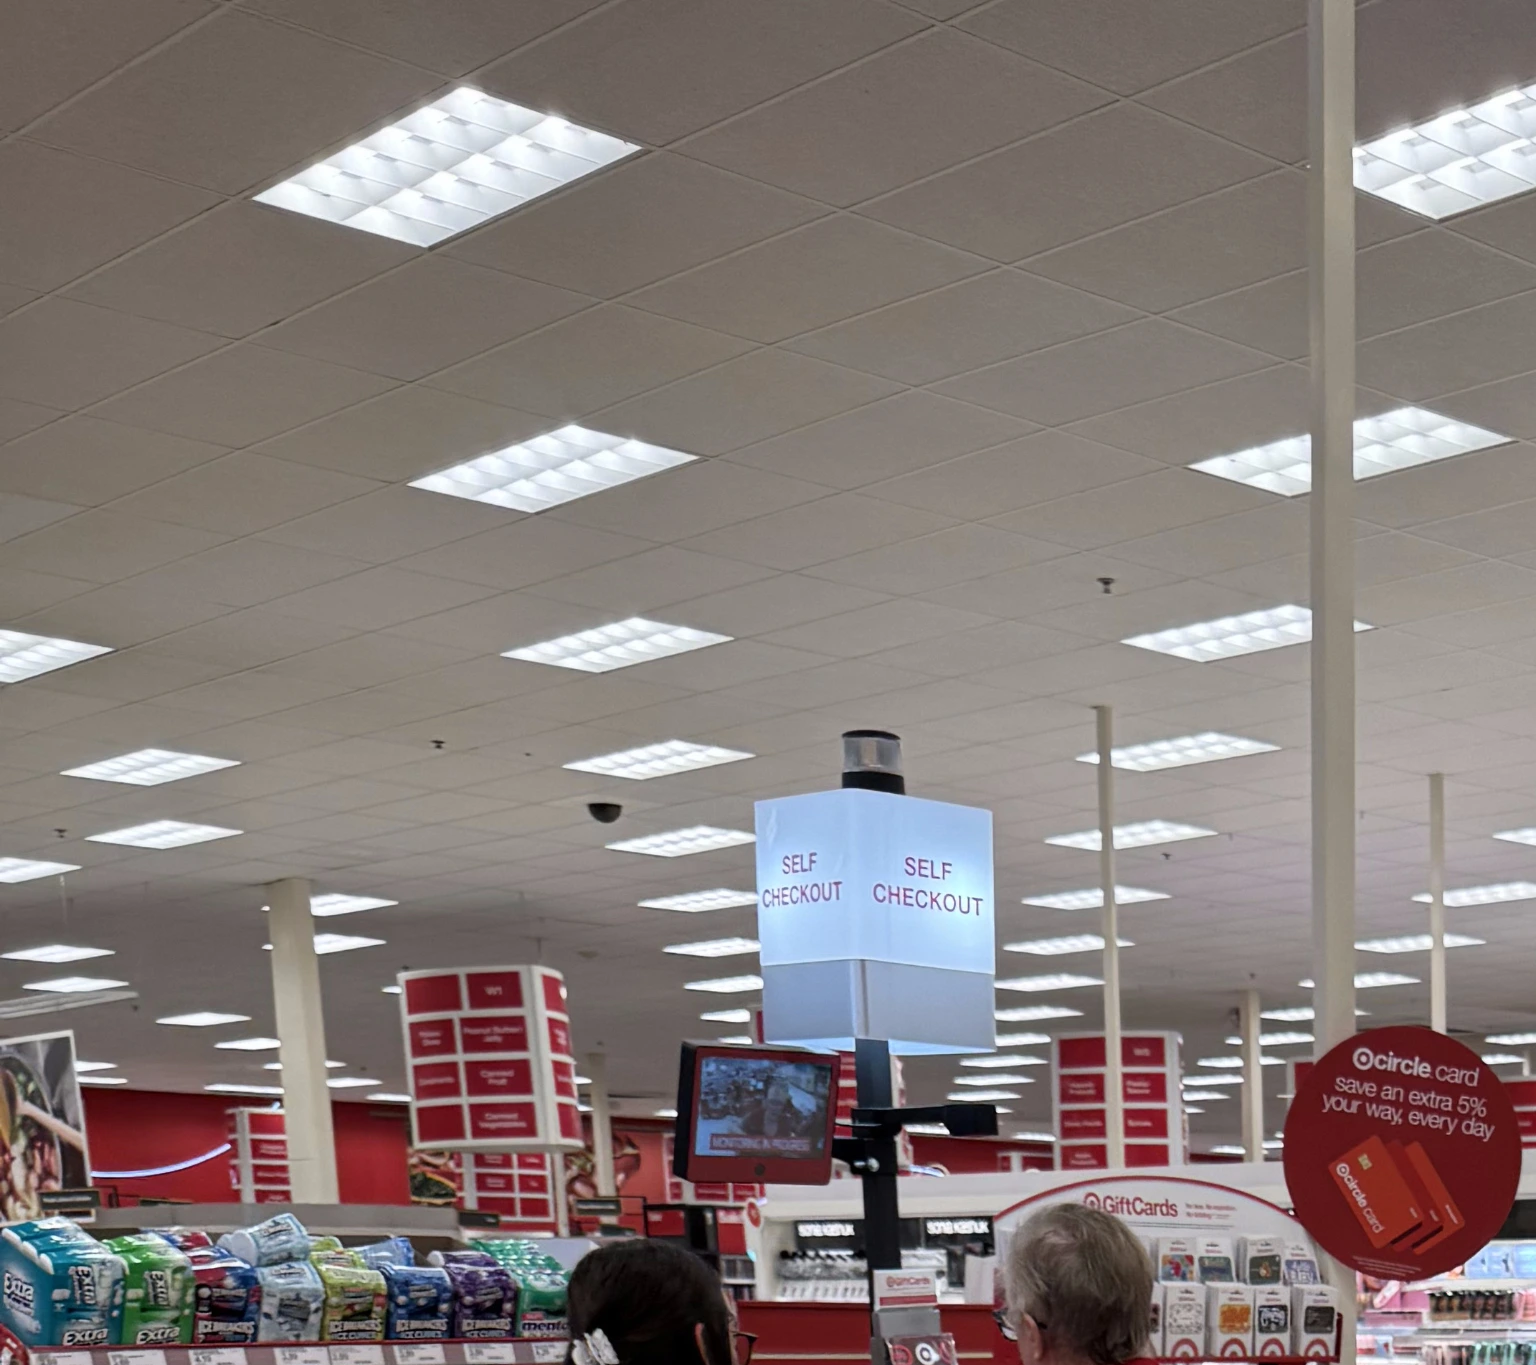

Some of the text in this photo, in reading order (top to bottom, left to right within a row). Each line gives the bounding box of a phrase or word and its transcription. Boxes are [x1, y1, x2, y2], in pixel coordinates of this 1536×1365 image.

[782, 852, 817, 874] SELF
[904, 857, 953, 880] SELF
[762, 881, 843, 907] CHECKOUT
[873, 883, 983, 916] CHECKOUT
[1373, 1051, 1479, 1087] circle card
[1335, 1077, 1487, 1118] save an extra 5%
[1322, 1094, 1495, 1142] your way, every day
[1103, 1195, 1178, 1217] GiftCards
[1345, 1173, 1385, 1234] circle card
[63, 1328, 108, 1345] Extra
[136, 1327, 180, 1345] Extra
[522, 1321, 568, 1331] mento
